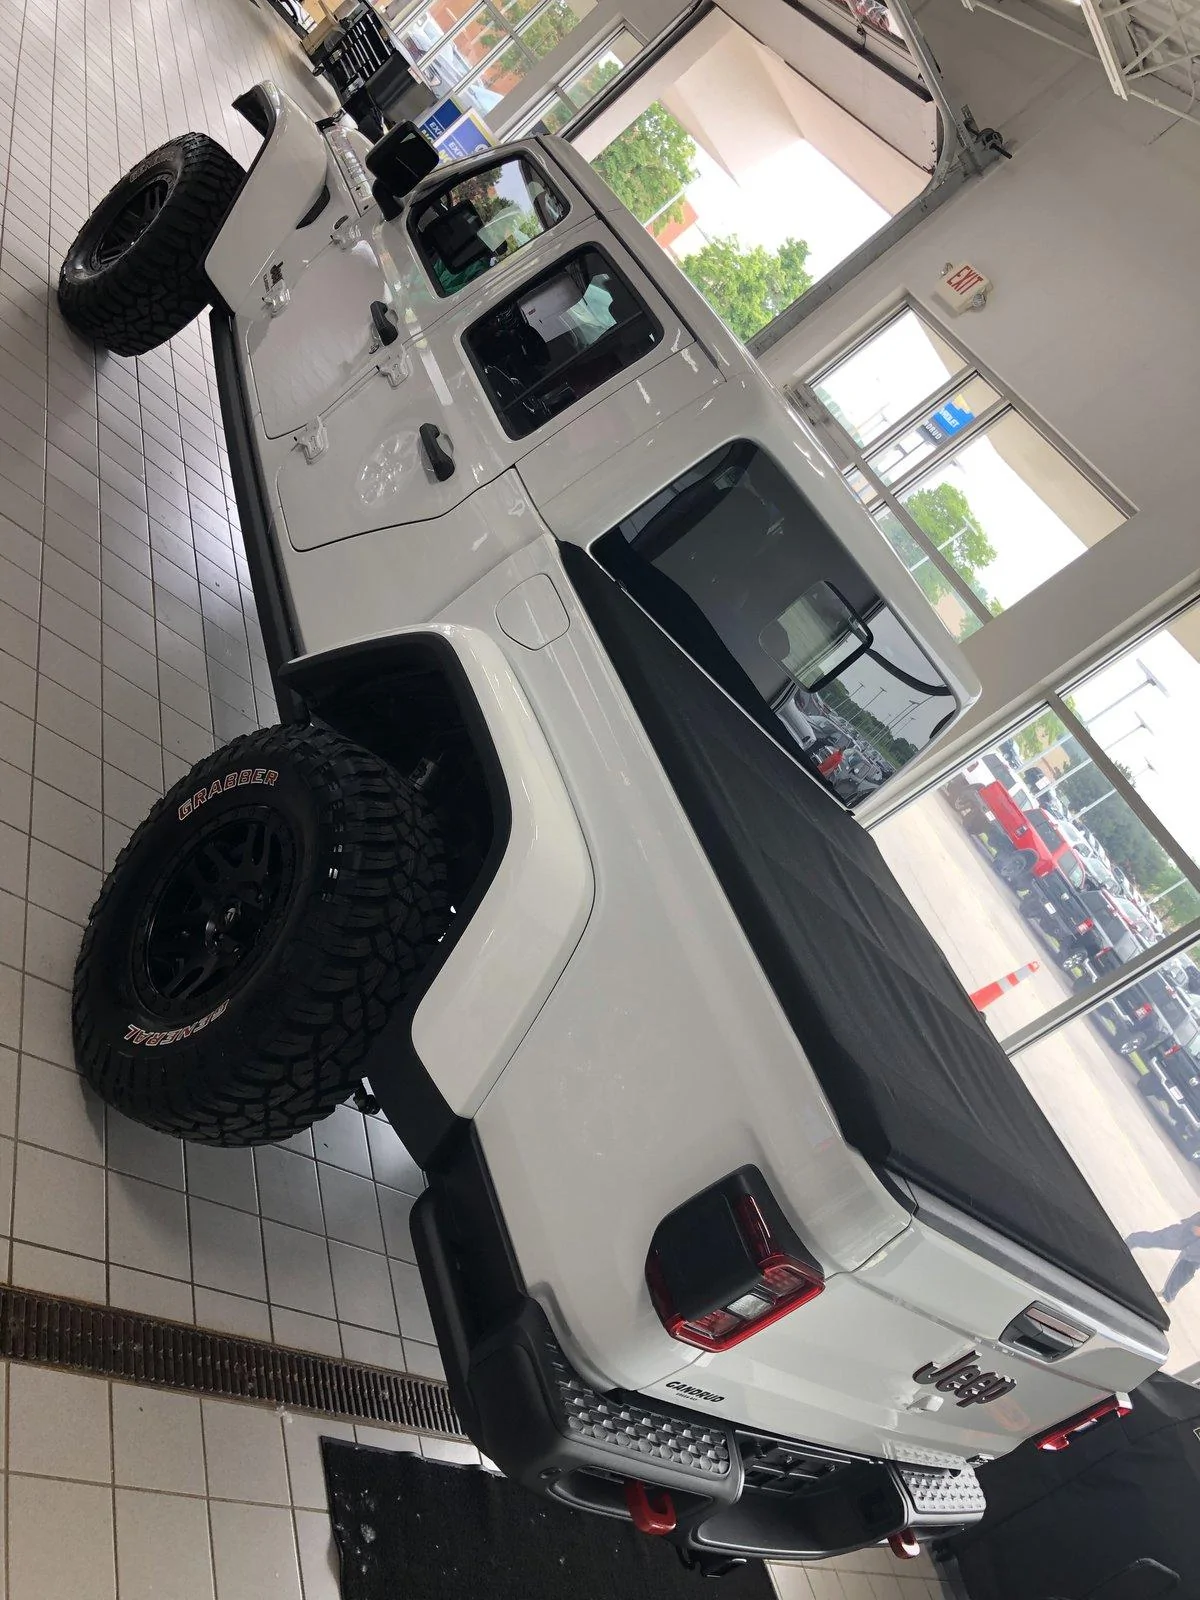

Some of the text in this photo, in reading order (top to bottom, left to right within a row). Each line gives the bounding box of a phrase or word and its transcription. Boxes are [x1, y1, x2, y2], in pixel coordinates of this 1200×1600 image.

[946, 265, 984, 295] EXIT
[178, 768, 279, 821] GRABBER
[124, 998, 230, 1047] GENERAL
[665, 1381, 725, 1403] GANDRUD
[912, 1350, 1017, 1408] Jeep
